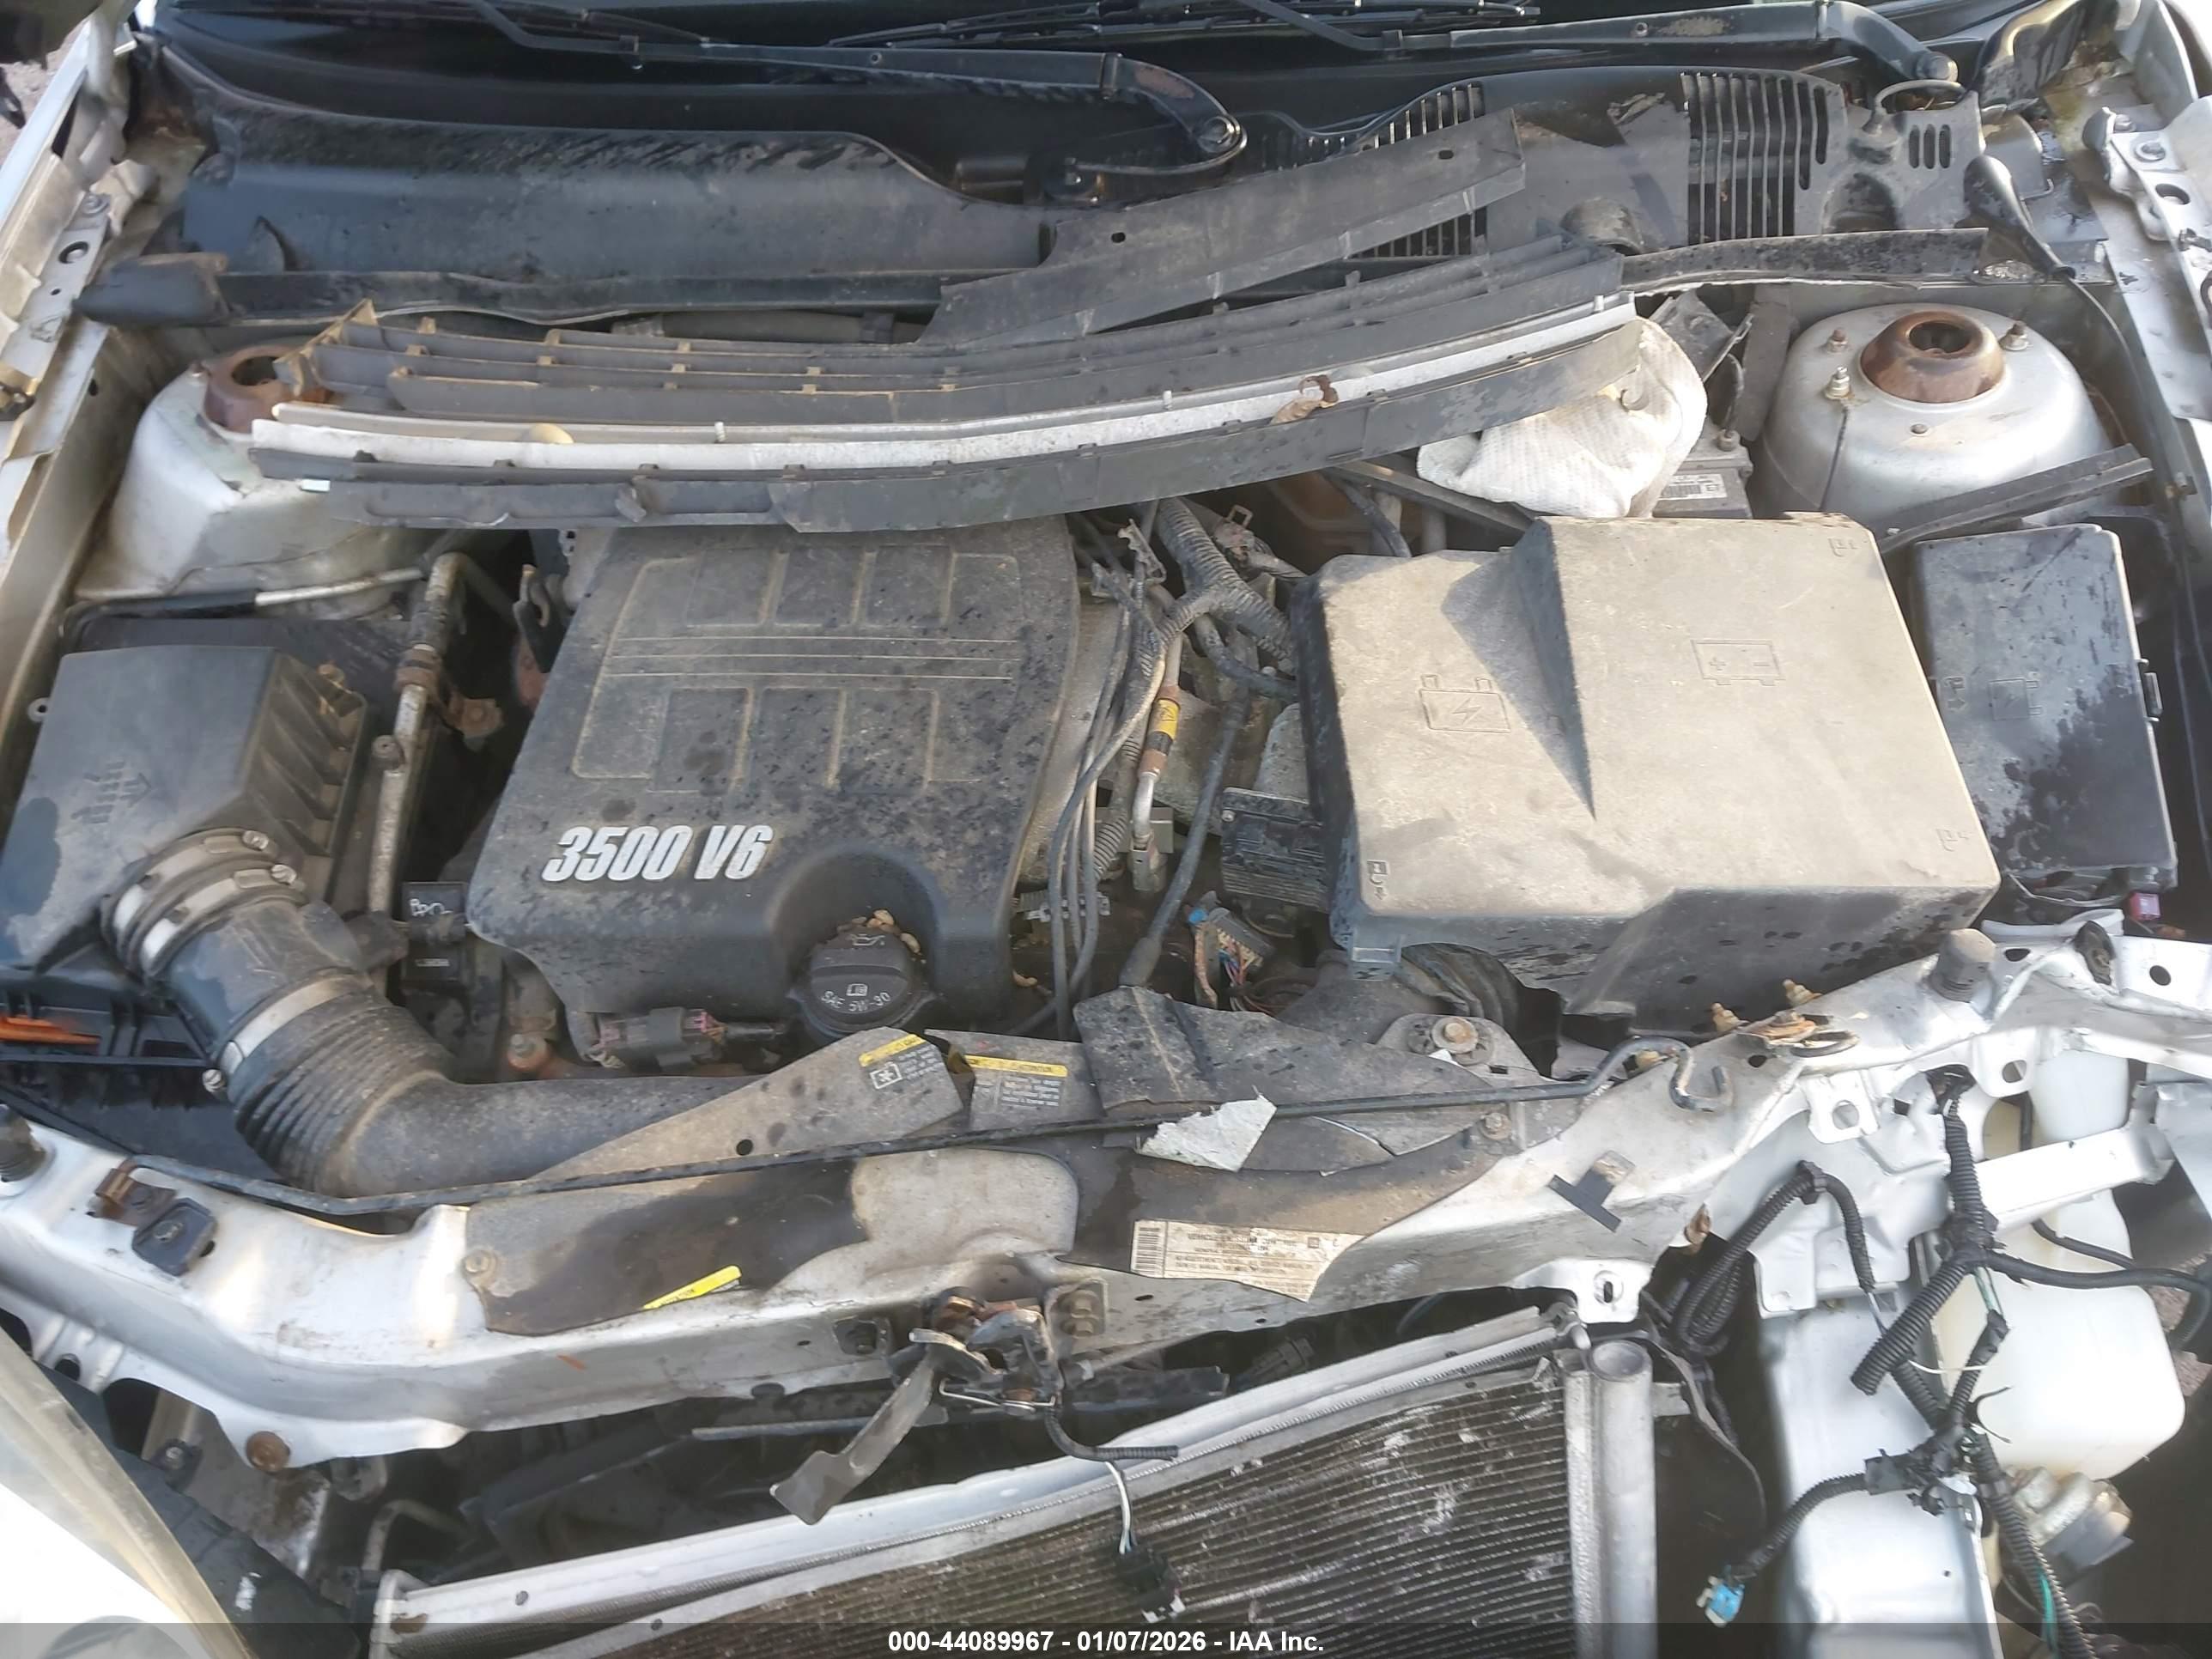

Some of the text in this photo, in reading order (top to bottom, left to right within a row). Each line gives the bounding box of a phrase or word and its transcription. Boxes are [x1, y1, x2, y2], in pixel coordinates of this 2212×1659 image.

[541, 825, 774, 882] 3500 V6
[821, 990, 845, 1009] SAE
